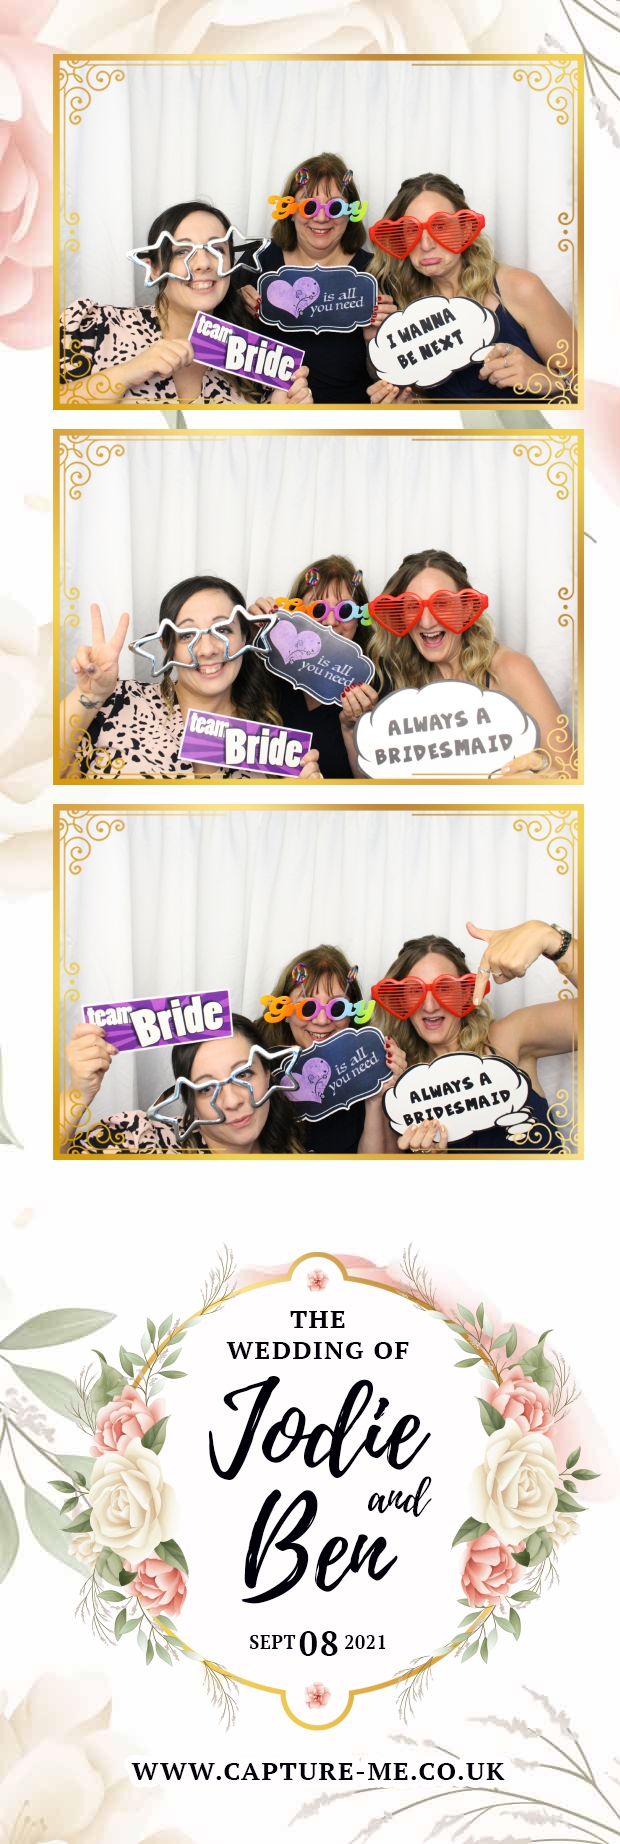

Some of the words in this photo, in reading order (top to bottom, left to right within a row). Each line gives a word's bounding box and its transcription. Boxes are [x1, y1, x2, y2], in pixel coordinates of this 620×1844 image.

[310, 302, 333, 318] you
[335, 296, 364, 311] need
[323, 292, 335, 303] is
[338, 287, 357, 300] all
[196, 314, 234, 344] team
[386, 333, 397, 350] I
[397, 308, 457, 344] WANNA
[225, 335, 295, 382] Bride
[397, 350, 418, 370] BE
[418, 328, 464, 361] NEXT
[298, 660, 324, 676] you
[324, 669, 355, 687] need
[317, 655, 331, 668] is
[332, 664, 354, 678] all
[189, 711, 230, 739] team
[388, 710, 469, 737] ALWAYS
[476, 707, 492, 725] A
[225, 728, 303, 768] Bride
[374, 733, 513, 766] BRIDESMAID
[86, 1005, 133, 1027] team
[130, 995, 224, 1048] Bride
[328, 1074, 352, 1097] you
[352, 1051, 379, 1078] need
[335, 1064, 348, 1076] is
[349, 1045, 369, 1067] all
[409, 1076, 474, 1105] ALWAYS
[479, 1071, 493, 1087] A
[402, 1089, 511, 1127] BRIDESMAID
